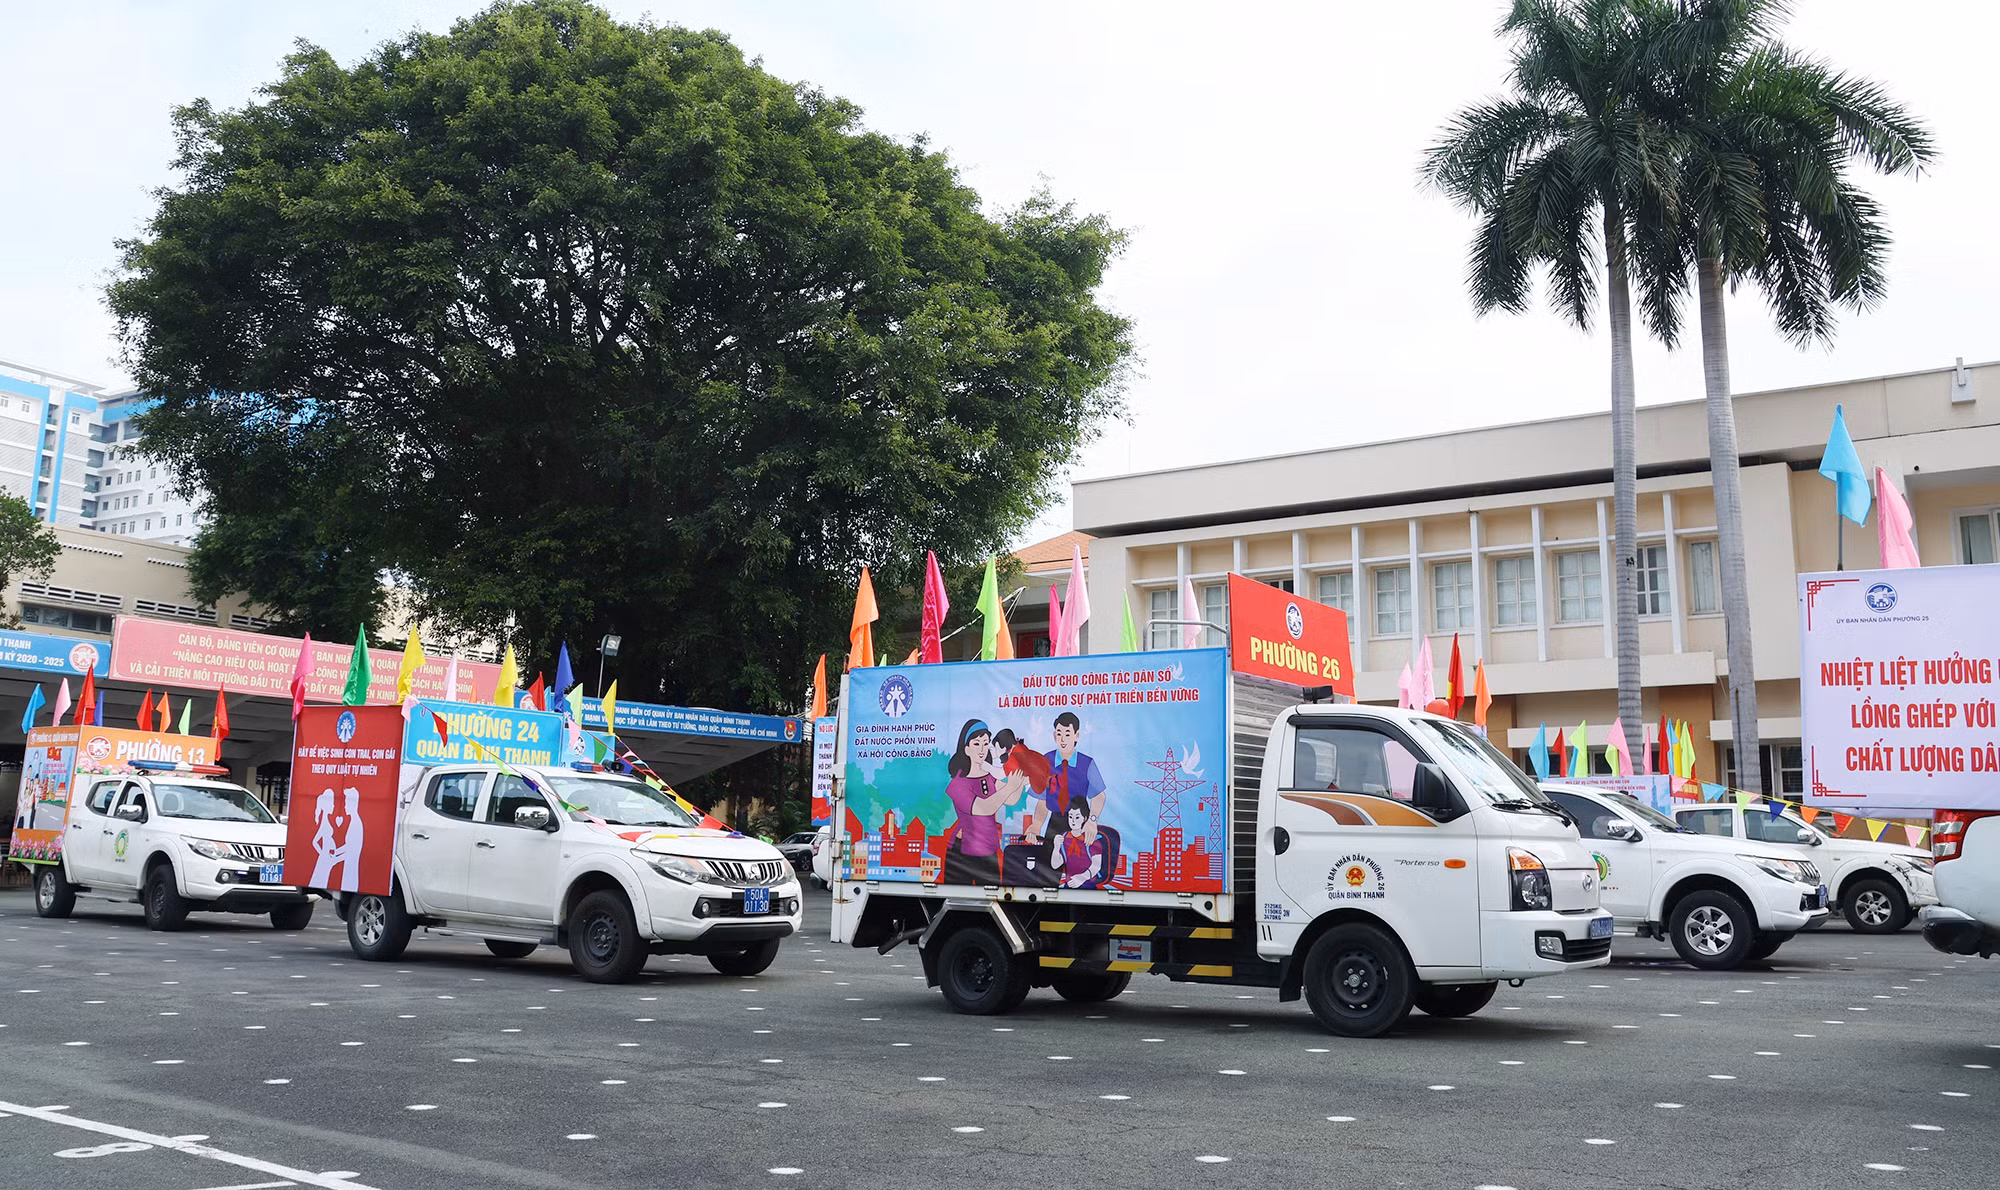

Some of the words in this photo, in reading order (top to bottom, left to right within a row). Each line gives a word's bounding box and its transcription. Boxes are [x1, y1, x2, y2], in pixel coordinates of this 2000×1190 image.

[4, 638, 31, 650] THẠNH
[5, 651, 15, 661] KỲ
[16, 654, 37, 664] 2020
[44, 657, 64, 667] 2025
[178, 633, 197, 646] CÁN
[199, 635, 214, 650] BỘ,
[217, 636, 241, 651] ĐẢNG
[243, 642, 262, 655] VIÊN
[265, 644, 277, 656] CƠ
[317, 651, 334, 661] BAN
[335, 653, 351, 664] NHÂ
[377, 658, 397, 672] QUẬN
[419, 664, 443, 676] THẠNH
[459, 668, 473, 679] ĐUA
[1250, 636, 1318, 676] PHƯỜNG
[1321, 656, 1340, 681] 26
[129, 660, 142, 674] VÀ
[145, 661, 161, 675] CẢI
[163, 665, 191, 679] THIỆN
[193, 668, 210, 681] MÔI
[213, 670, 248, 685] TRƯỜNG
[270, 678, 284, 691] TƯ,
[310, 679, 326, 693] ĐẨY
[377, 690, 395, 700] KINH
[204, 653, 222, 666] CAO
[225, 655, 245, 669] HIỆU
[247, 655, 264, 671] QUẢ
[267, 661, 290, 675] HOẠT
[316, 666, 338, 679] CÔNG
[412, 677, 430, 689] CÁCH
[1045, 674, 1058, 687] TƯ
[1059, 675, 1078, 687] CHO
[1081, 671, 1108, 685] CÔNG
[1112, 670, 1130, 684] TÁC
[1133, 668, 1154, 683] DÂN
[1157, 665, 1171, 682] SỐ
[1821, 657, 1874, 691] NHIỆT
[1880, 655, 1918, 690] LIỆT
[1924, 651, 1991, 685] HƯỞNG
[999, 694, 1010, 708] LÀ
[1034, 694, 1047, 707] TƯ
[1048, 694, 1067, 706] CHO
[1070, 692, 1084, 708] SỰ
[1086, 690, 1111, 704] PHÁT
[1115, 686, 1144, 704] TRIỂN
[1147, 686, 1167, 702] BỀN
[1170, 687, 1199, 701] VỮNG
[631, 707, 642, 715] NIÊN
[652, 710, 665, 718] QUAN
[685, 712, 698, 721] NHÂN
[699, 713, 709, 721] DÂN
[710, 715, 722, 724] QUẬN
[723, 717, 735, 725] BÌNH
[735, 719, 751, 727] THẠNH
[1851, 696, 1900, 728] LỒNG
[1906, 698, 1957, 728] GHÉP
[1963, 697, 1996, 728] VỚI
[516, 721, 539, 742] 24
[615, 717, 626, 725] HỌC
[627, 716, 637, 726] TẬP
[638, 717, 645, 726] VÀ
[646, 718, 657, 727] LÀM
[658, 720, 672, 728] THEO
[672, 720, 680, 729] TƯ
[698, 724, 708, 733] ĐẠO
[737, 726, 749, 735] CÁCH
[750, 727, 757, 736] HỒ
[757, 728, 765, 736] CHÍ
[871, 724, 889, 733] ĐÌNH
[891, 724, 912, 735] HẠNH
[914, 722, 935, 732] PHÚC
[416, 740, 459, 761] QUẬN
[855, 735, 869, 746] ĐẤT
[870, 735, 892, 745] NƯỚC
[116, 738, 183, 763] PHƯỜNG
[188, 747, 205, 765] 13
[309, 744, 318, 757] ĐỂ
[318, 746, 329, 760] VIỆC
[330, 748, 344, 758] SINH
[344, 749, 356, 758] CON
[372, 749, 384, 759] CON
[385, 747, 396, 759] GÁI
[870, 748, 883, 760] HỘI
[885, 748, 908, 758] CÔNG
[1846, 738, 1894, 771] CHẤT
[1899, 744, 1964, 777] LƯỢNG
[312, 764, 325, 774] THEO
[326, 764, 337, 775] QUY
[337, 763, 351, 776] LUẬT
[352, 764, 360, 777] TỰ
[360, 764, 378, 775] NHIÊN
[1327, 867, 1337, 881] BAN
[1334, 855, 1351, 869] NHÂN
[1352, 853, 1365, 862] DÂN
[1365, 857, 1384, 881] PHƯỜNG
[1377, 882, 1385, 891] 26
[750, 889, 763, 900] 50A
[1328, 890, 1345, 900] QUẬN
[1346, 890, 1361, 899] BÌNH
[1363, 891, 1385, 900] THẠNH
